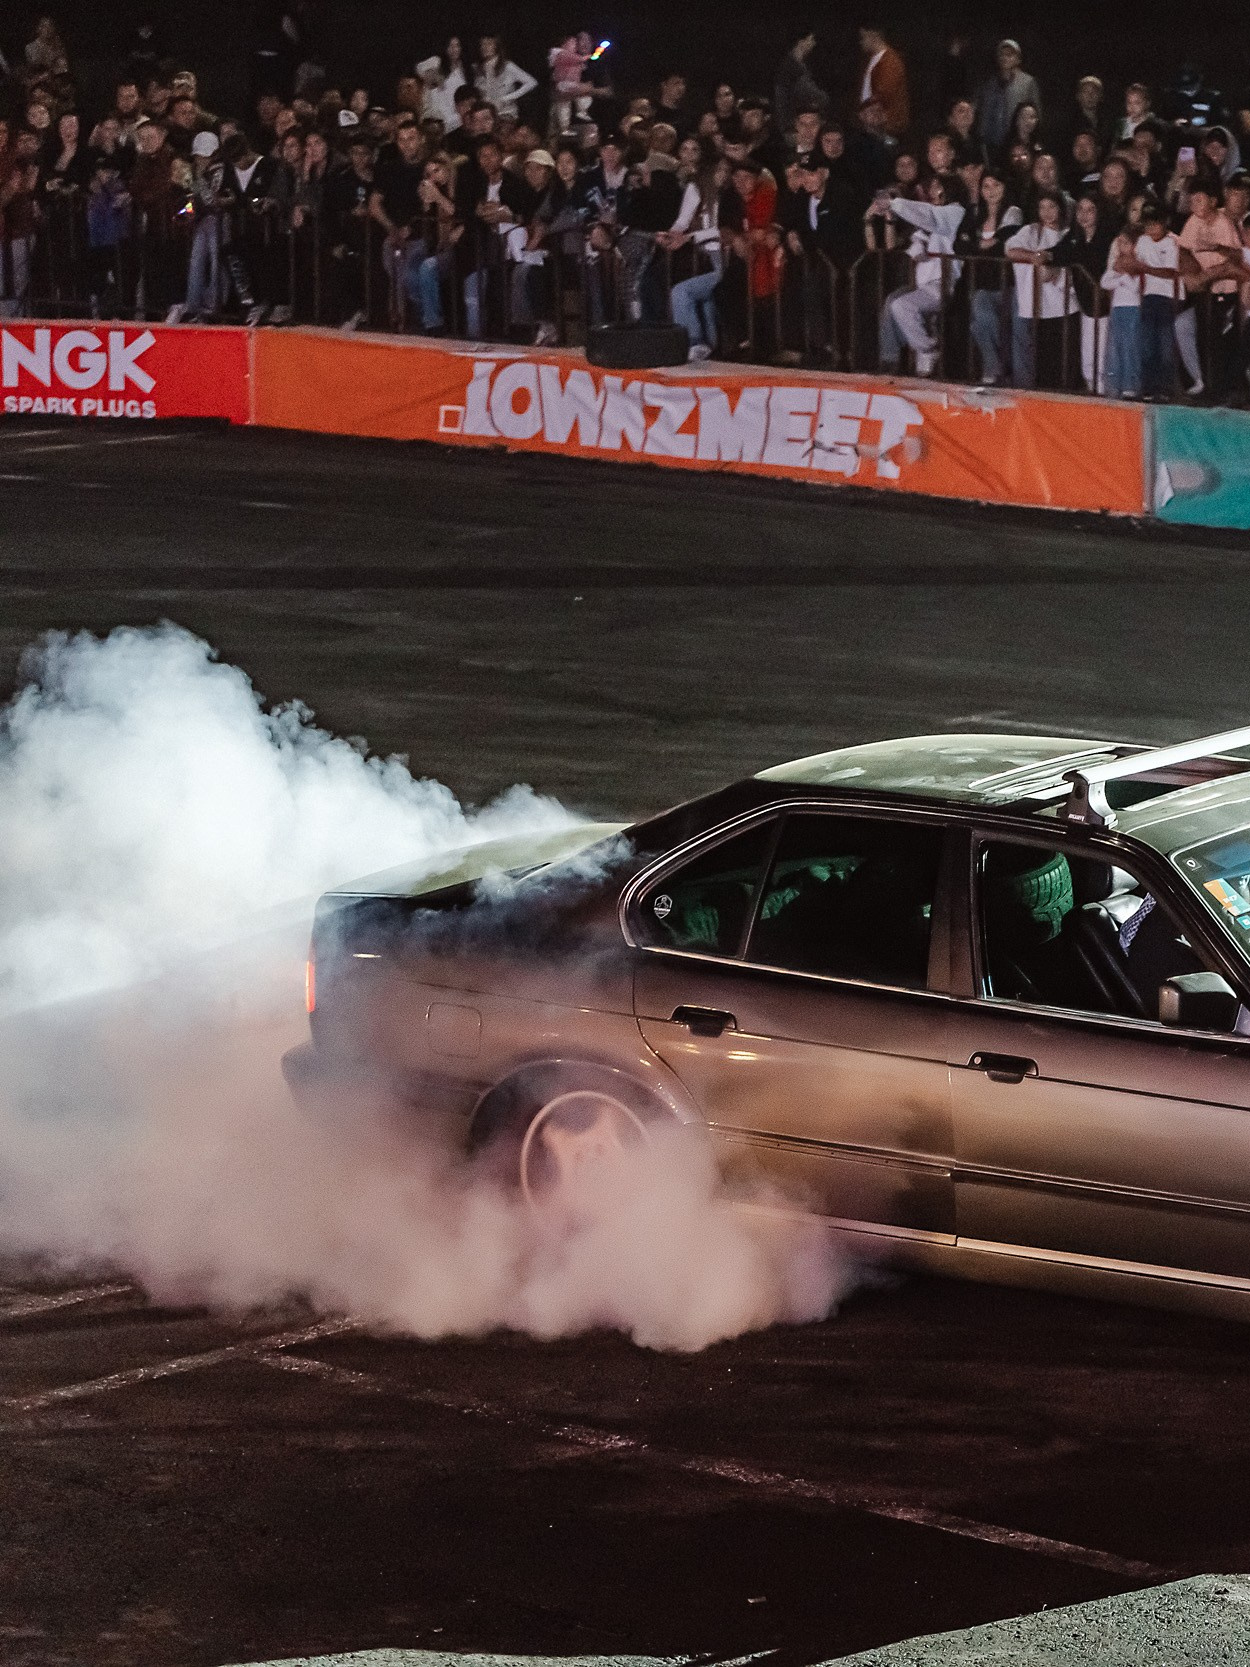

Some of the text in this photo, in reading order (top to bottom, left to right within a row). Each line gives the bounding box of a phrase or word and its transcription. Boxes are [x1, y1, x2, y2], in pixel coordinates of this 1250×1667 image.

[2, 329, 156, 394] NGK
[3, 395, 157, 419] SPARK PLUGS
